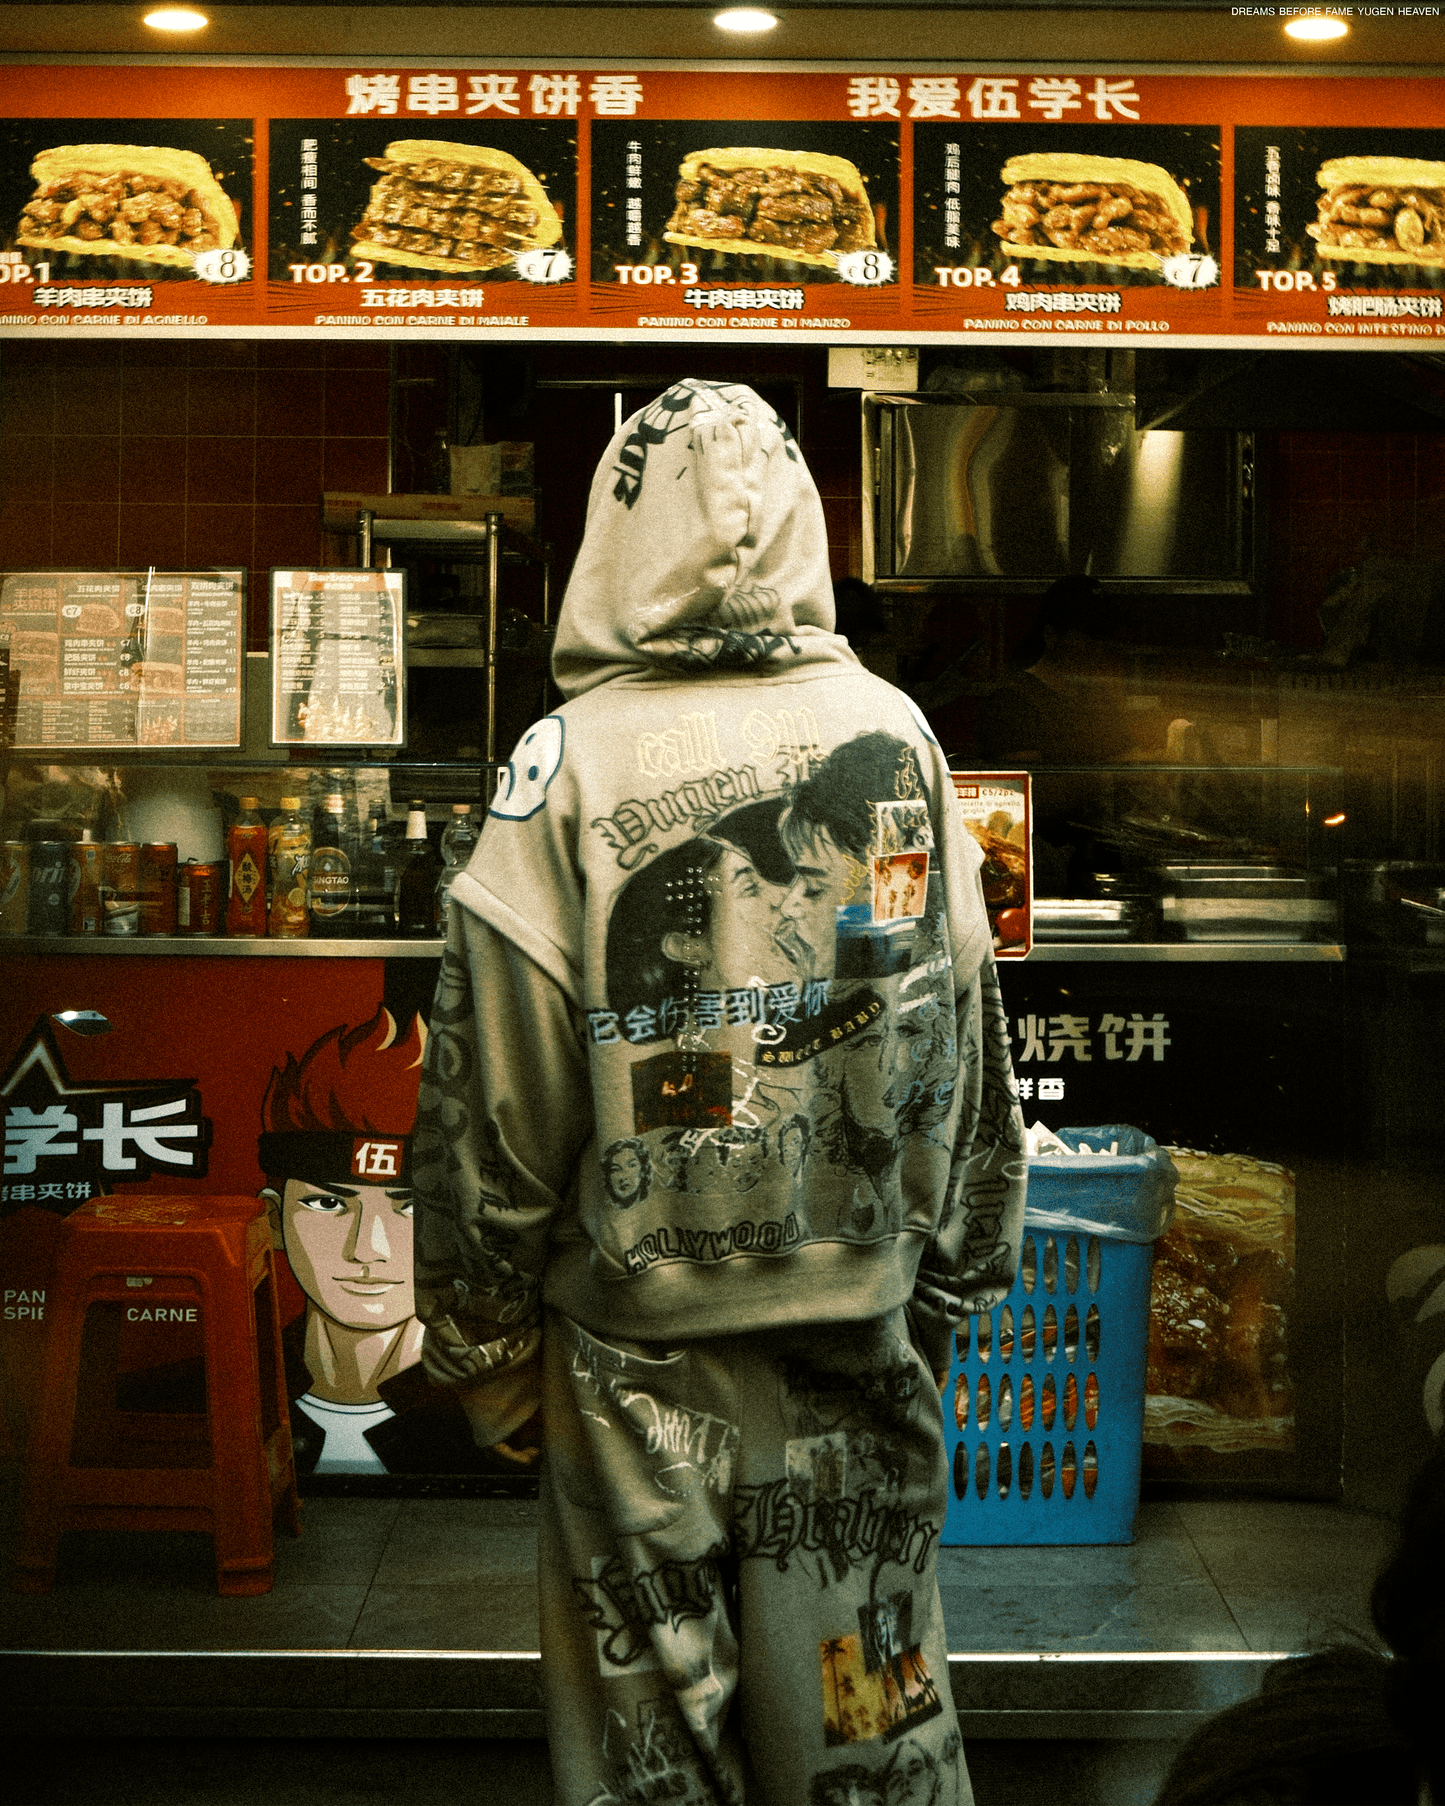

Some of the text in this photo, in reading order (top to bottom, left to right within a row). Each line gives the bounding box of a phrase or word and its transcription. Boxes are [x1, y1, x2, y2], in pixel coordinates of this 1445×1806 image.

[346, 73, 644, 116] 烤串夹饼香
[848, 76, 1140, 121] 我爱伍学长
[34, 287, 153, 308] 羊肉串夹饼
[360, 288, 485, 308] 五花肉夹饼
[684, 288, 805, 310] 牛肉串夹饼
[1004, 292, 1122, 313] 鸡肉串夹饼
[0, 315, 208, 325] NINO CON CARNE DI AGNELLO
[315, 316, 529, 326] PANINO CON CARNE DI MAIALE
[638, 317, 850, 329] PANINO CON CARNE DI MANZO
[963, 319, 1170, 331] PANINO CON CARNE DI POLLO
[1267, 321, 1322, 333] PANINO
[1324, 322, 1355, 334] CON
[1358, 323, 1432, 335] INTESTINO
[1004, 1013, 1171, 1062] 烧饼
[3, 1099, 198, 1175] 学长
[355, 1142, 399, 1176] 伍
[126, 1307, 198, 1322] CARNE
